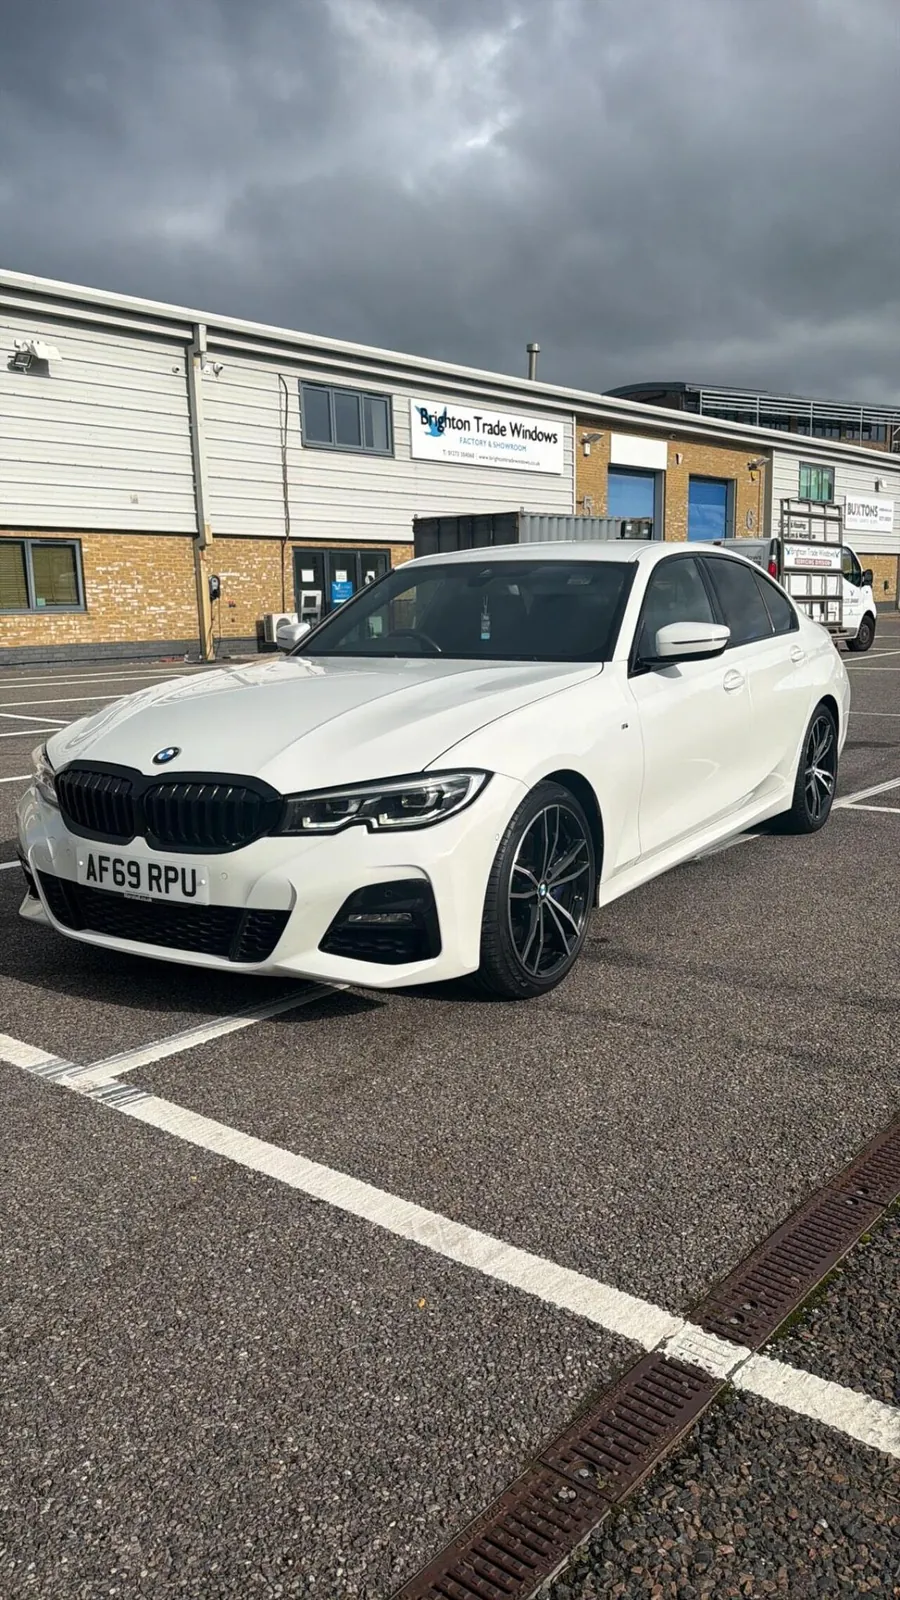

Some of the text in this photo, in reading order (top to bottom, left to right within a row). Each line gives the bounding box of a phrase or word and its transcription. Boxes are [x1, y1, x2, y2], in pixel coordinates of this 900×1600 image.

[420, 407, 558, 444] Brighton Trade Windows
[459, 437, 527, 452] FACTORY & SHOWROOM
[746, 507, 755, 530] 6
[847, 502, 879, 518] BUXTONS
[86, 853, 196, 897] AF69 RPU
